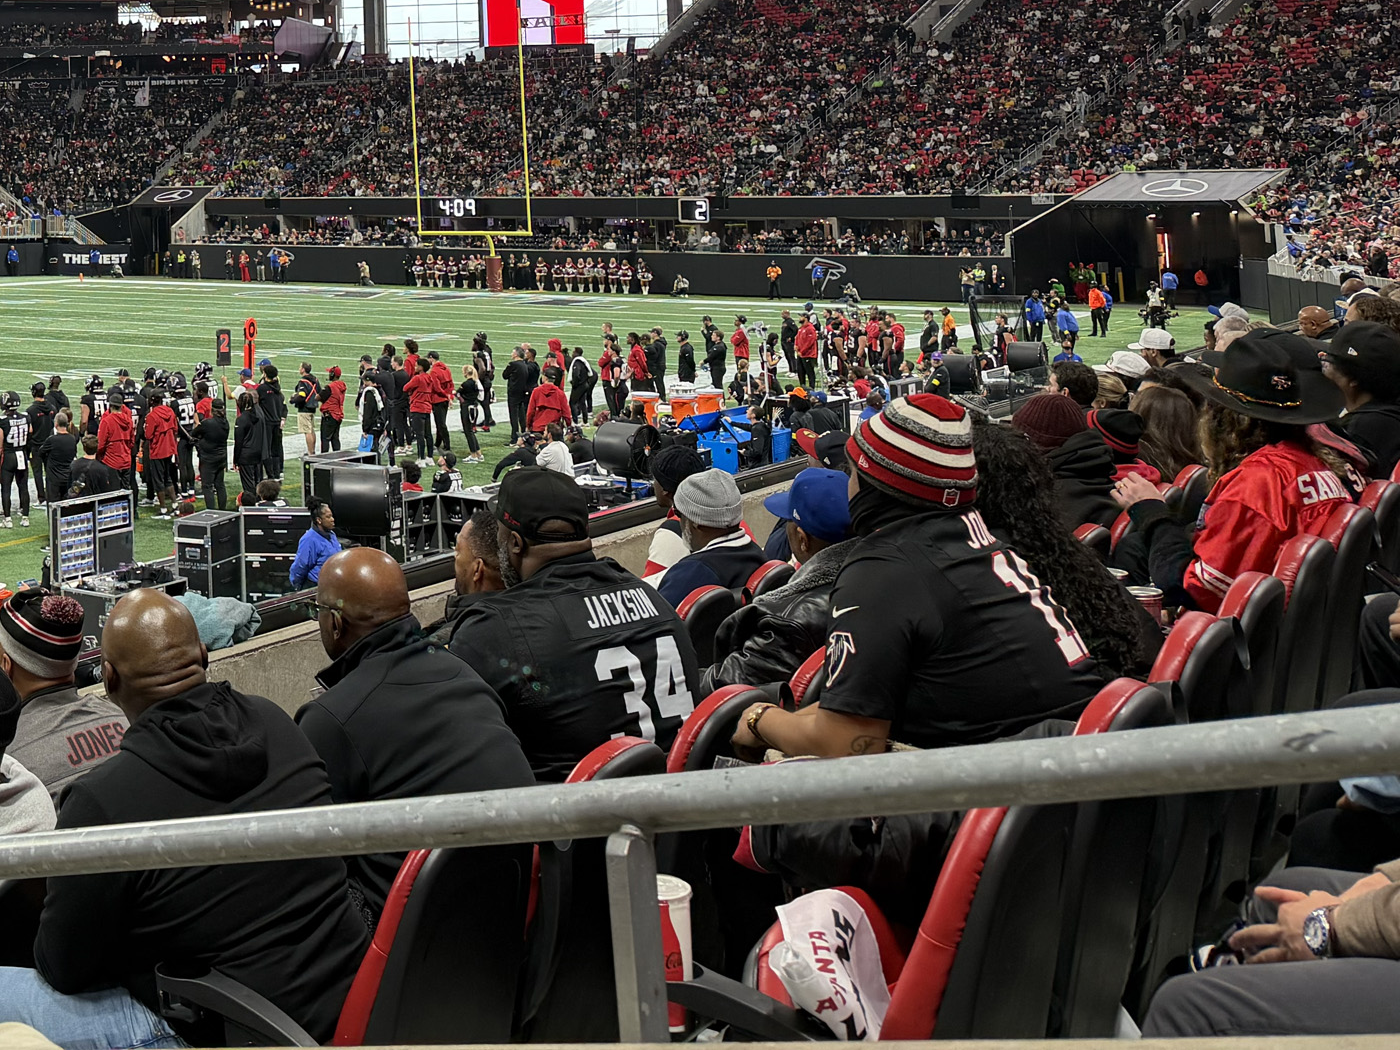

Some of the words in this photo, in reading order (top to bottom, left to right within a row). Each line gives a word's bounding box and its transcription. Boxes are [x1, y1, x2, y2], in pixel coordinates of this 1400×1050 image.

[439, 199, 476, 217] 4:09
[694, 201, 707, 220] 2
[62, 253, 90, 264] THE
[220, 334, 230, 352] 2
[6, 424, 28, 447] 40
[583, 587, 660, 629] JACKSON
[594, 635, 695, 744] 34
[65, 722, 126, 768] JONES
